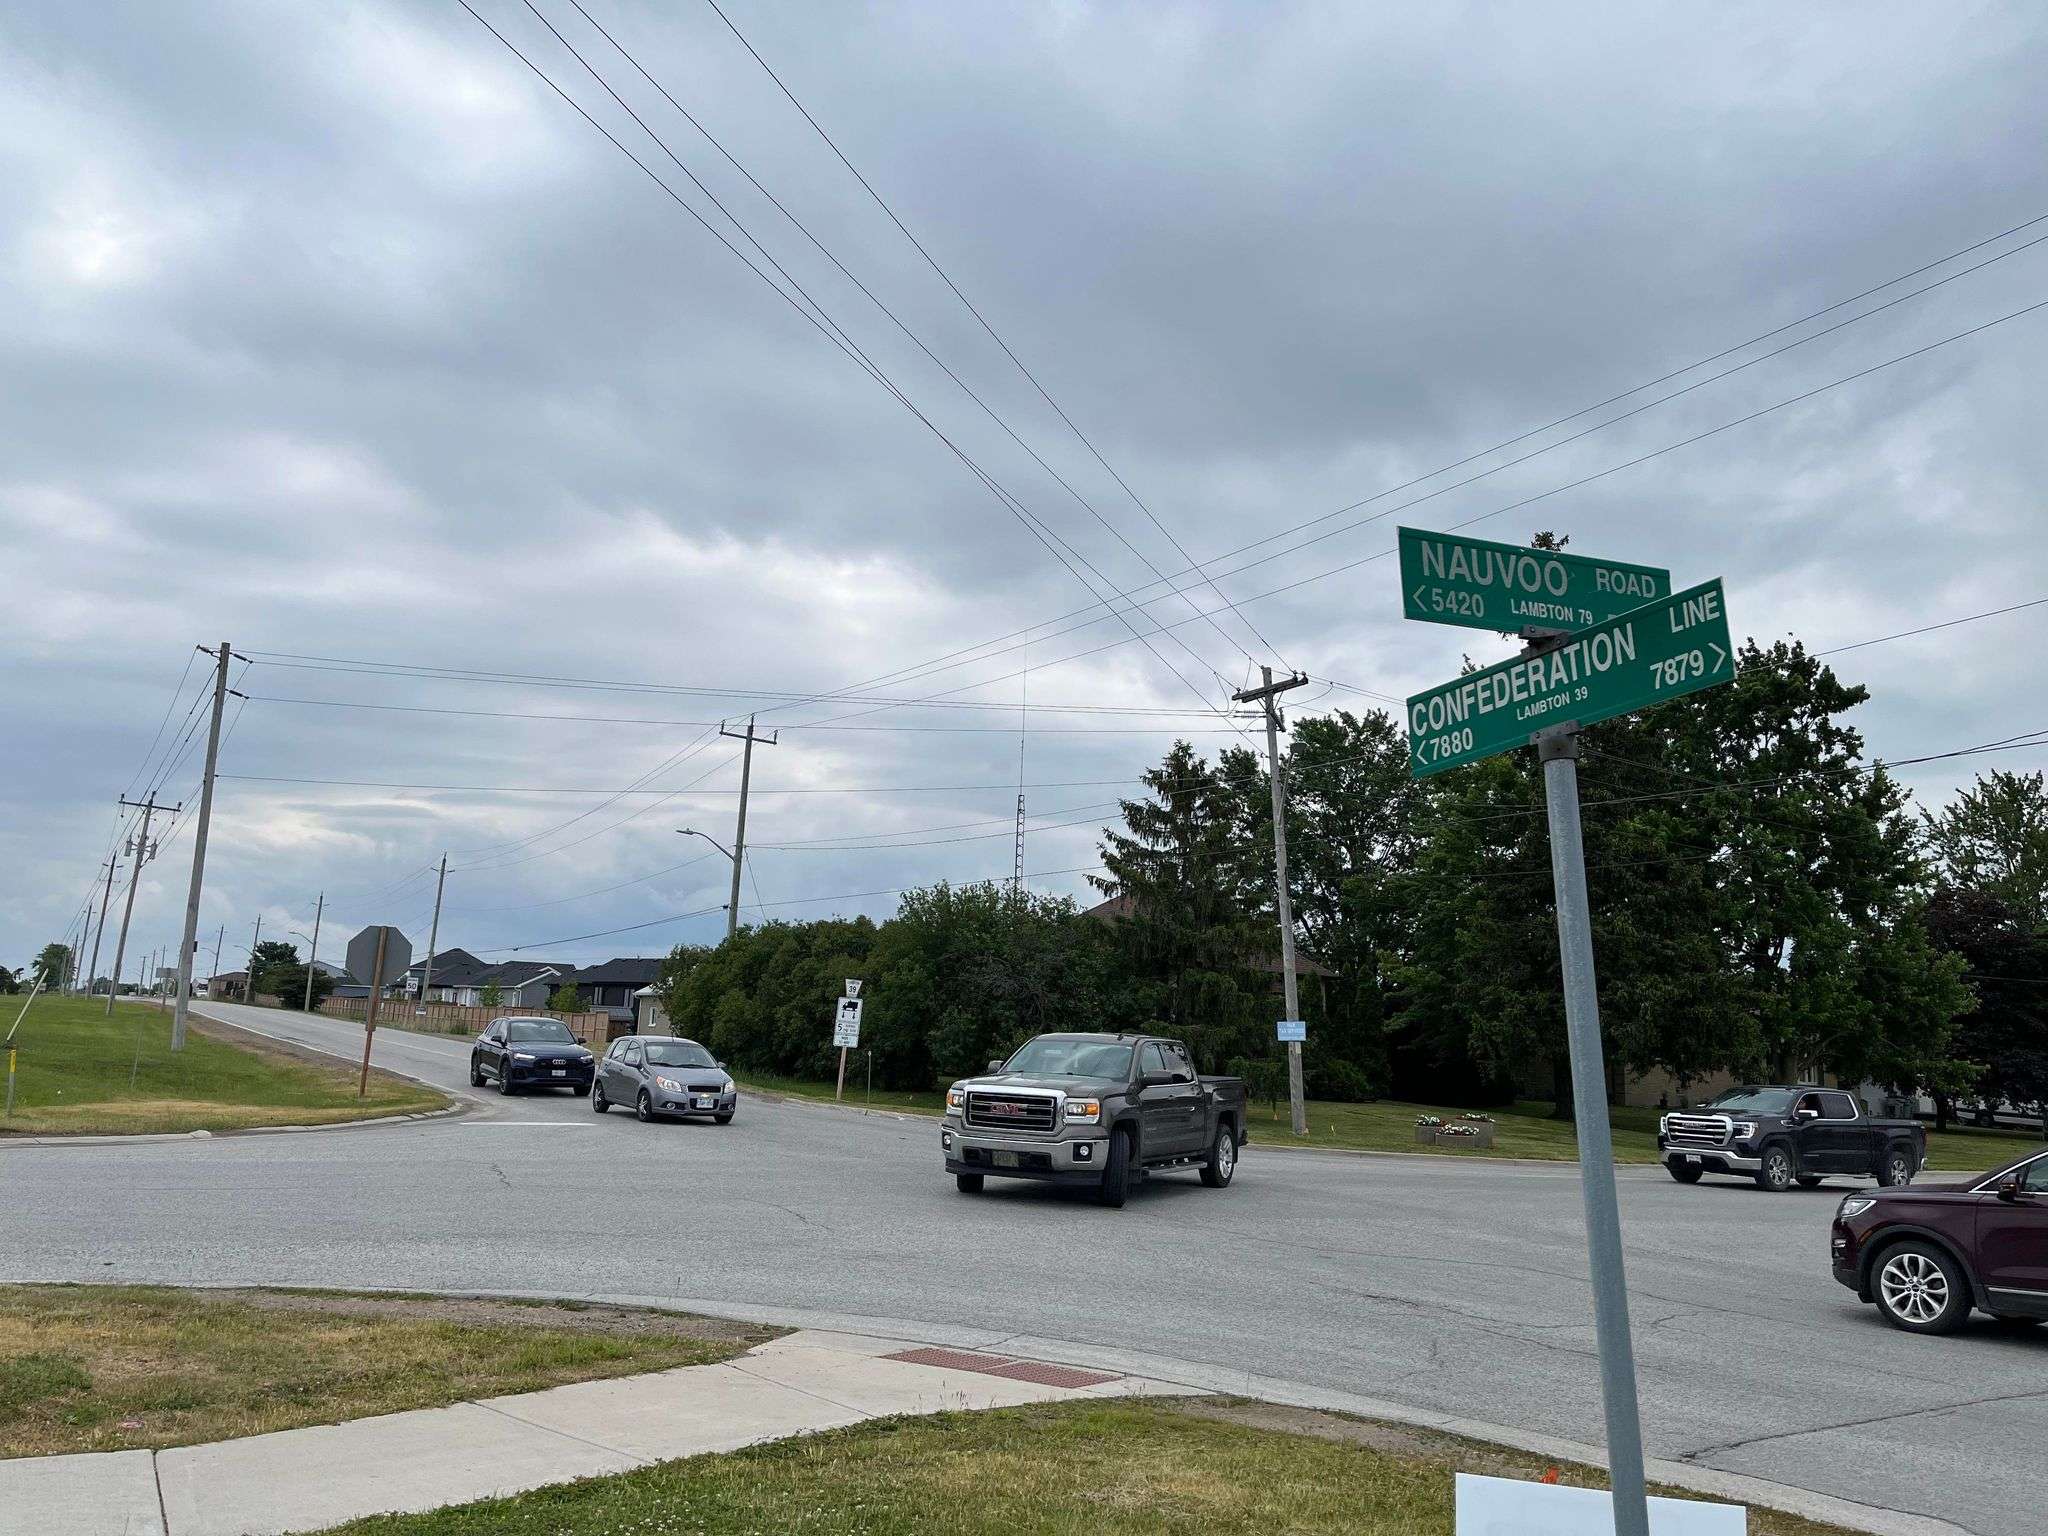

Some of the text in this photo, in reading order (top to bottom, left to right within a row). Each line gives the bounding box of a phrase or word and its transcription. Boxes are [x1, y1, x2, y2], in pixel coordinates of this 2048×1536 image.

[1421, 540, 1656, 598] NAUVOO ROAD
[1432, 588, 1484, 618] 5420
[1511, 599, 1593, 625] LAMBTON 79
[1412, 590, 1720, 737] CONFEDERATION LINE
[1650, 649, 1704, 690] 7879
[1516, 686, 1588, 721] LAMBTON 39
[1430, 727, 1473, 761] 7880
[407, 982, 417, 990] 50
[848, 985, 857, 993] 39
